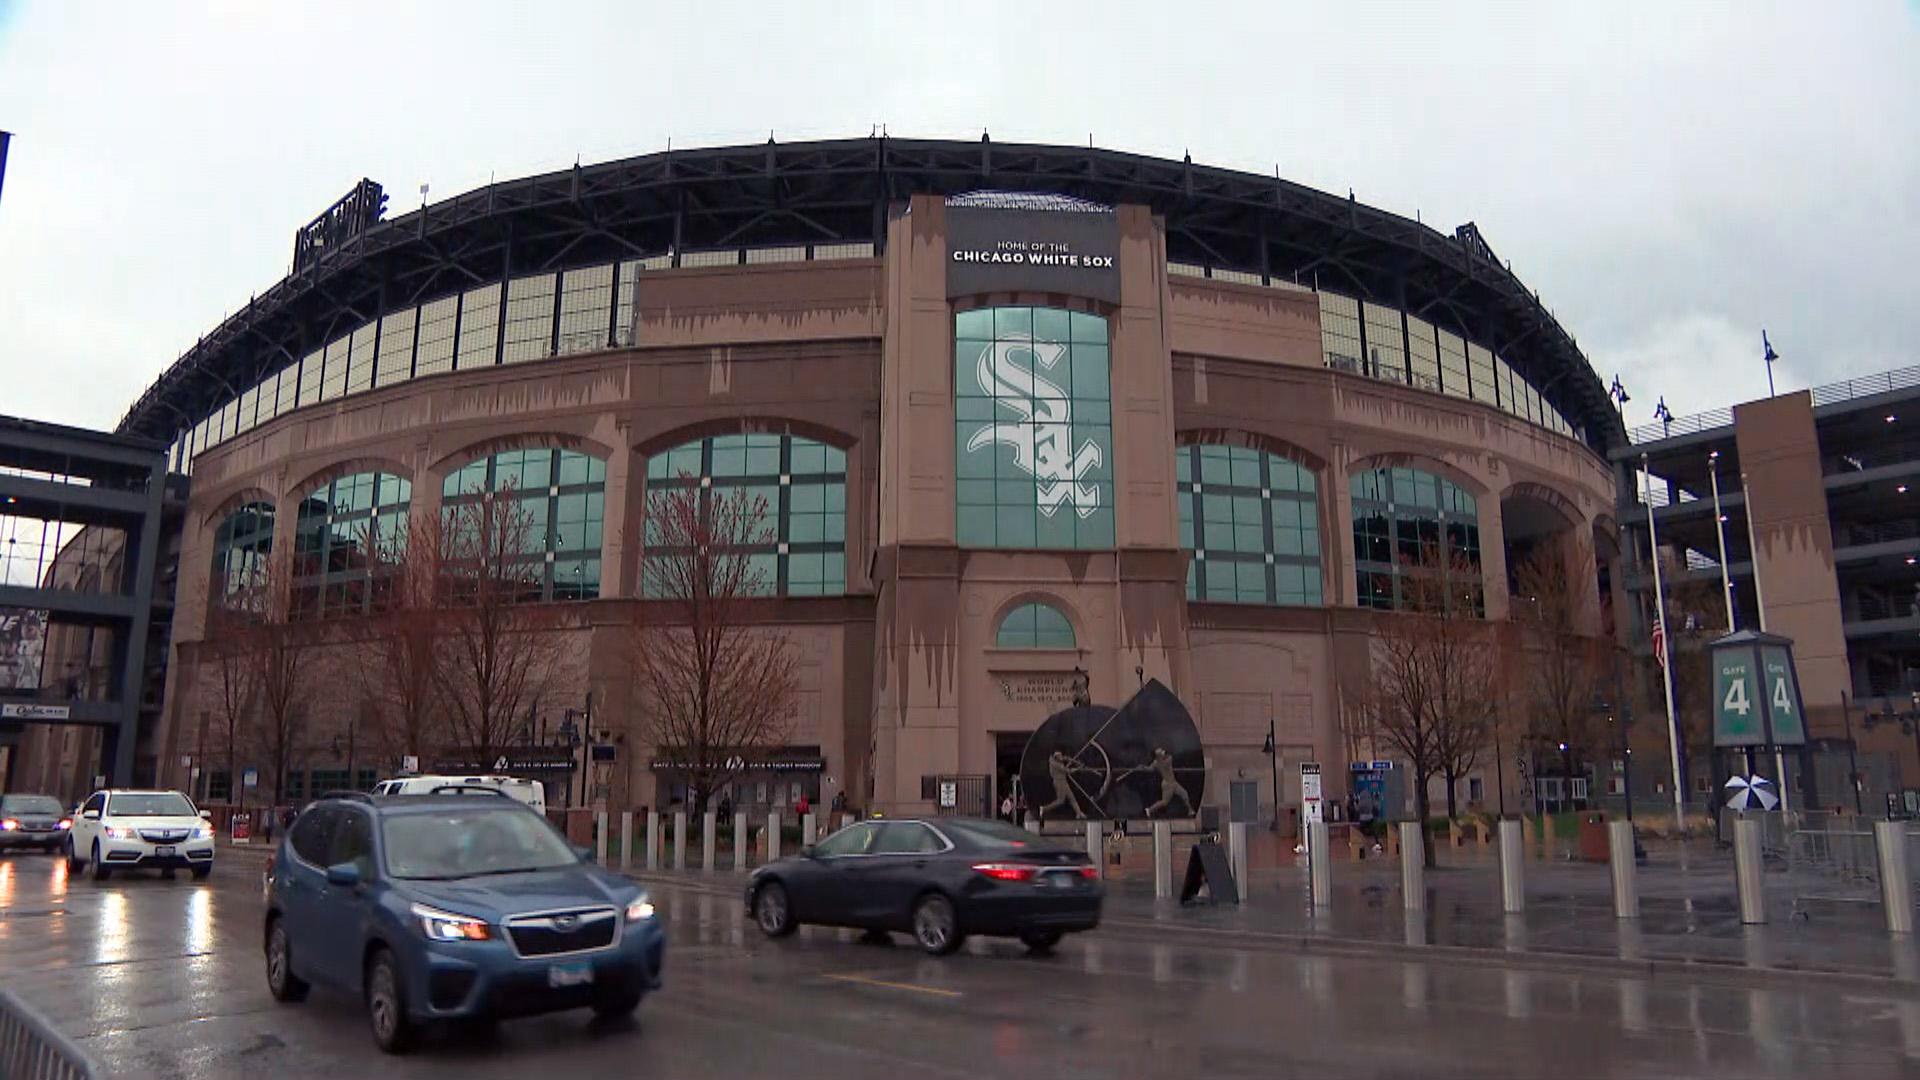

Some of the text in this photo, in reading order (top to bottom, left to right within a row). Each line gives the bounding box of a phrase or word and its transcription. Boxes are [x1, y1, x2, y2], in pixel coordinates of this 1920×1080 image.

[953, 251, 1113, 267] CHICAGO WHITE SOX
[997, 241, 1069, 252] HOME OF THE
[1724, 678, 1751, 716] 4
[1773, 677, 1793, 715] 4
